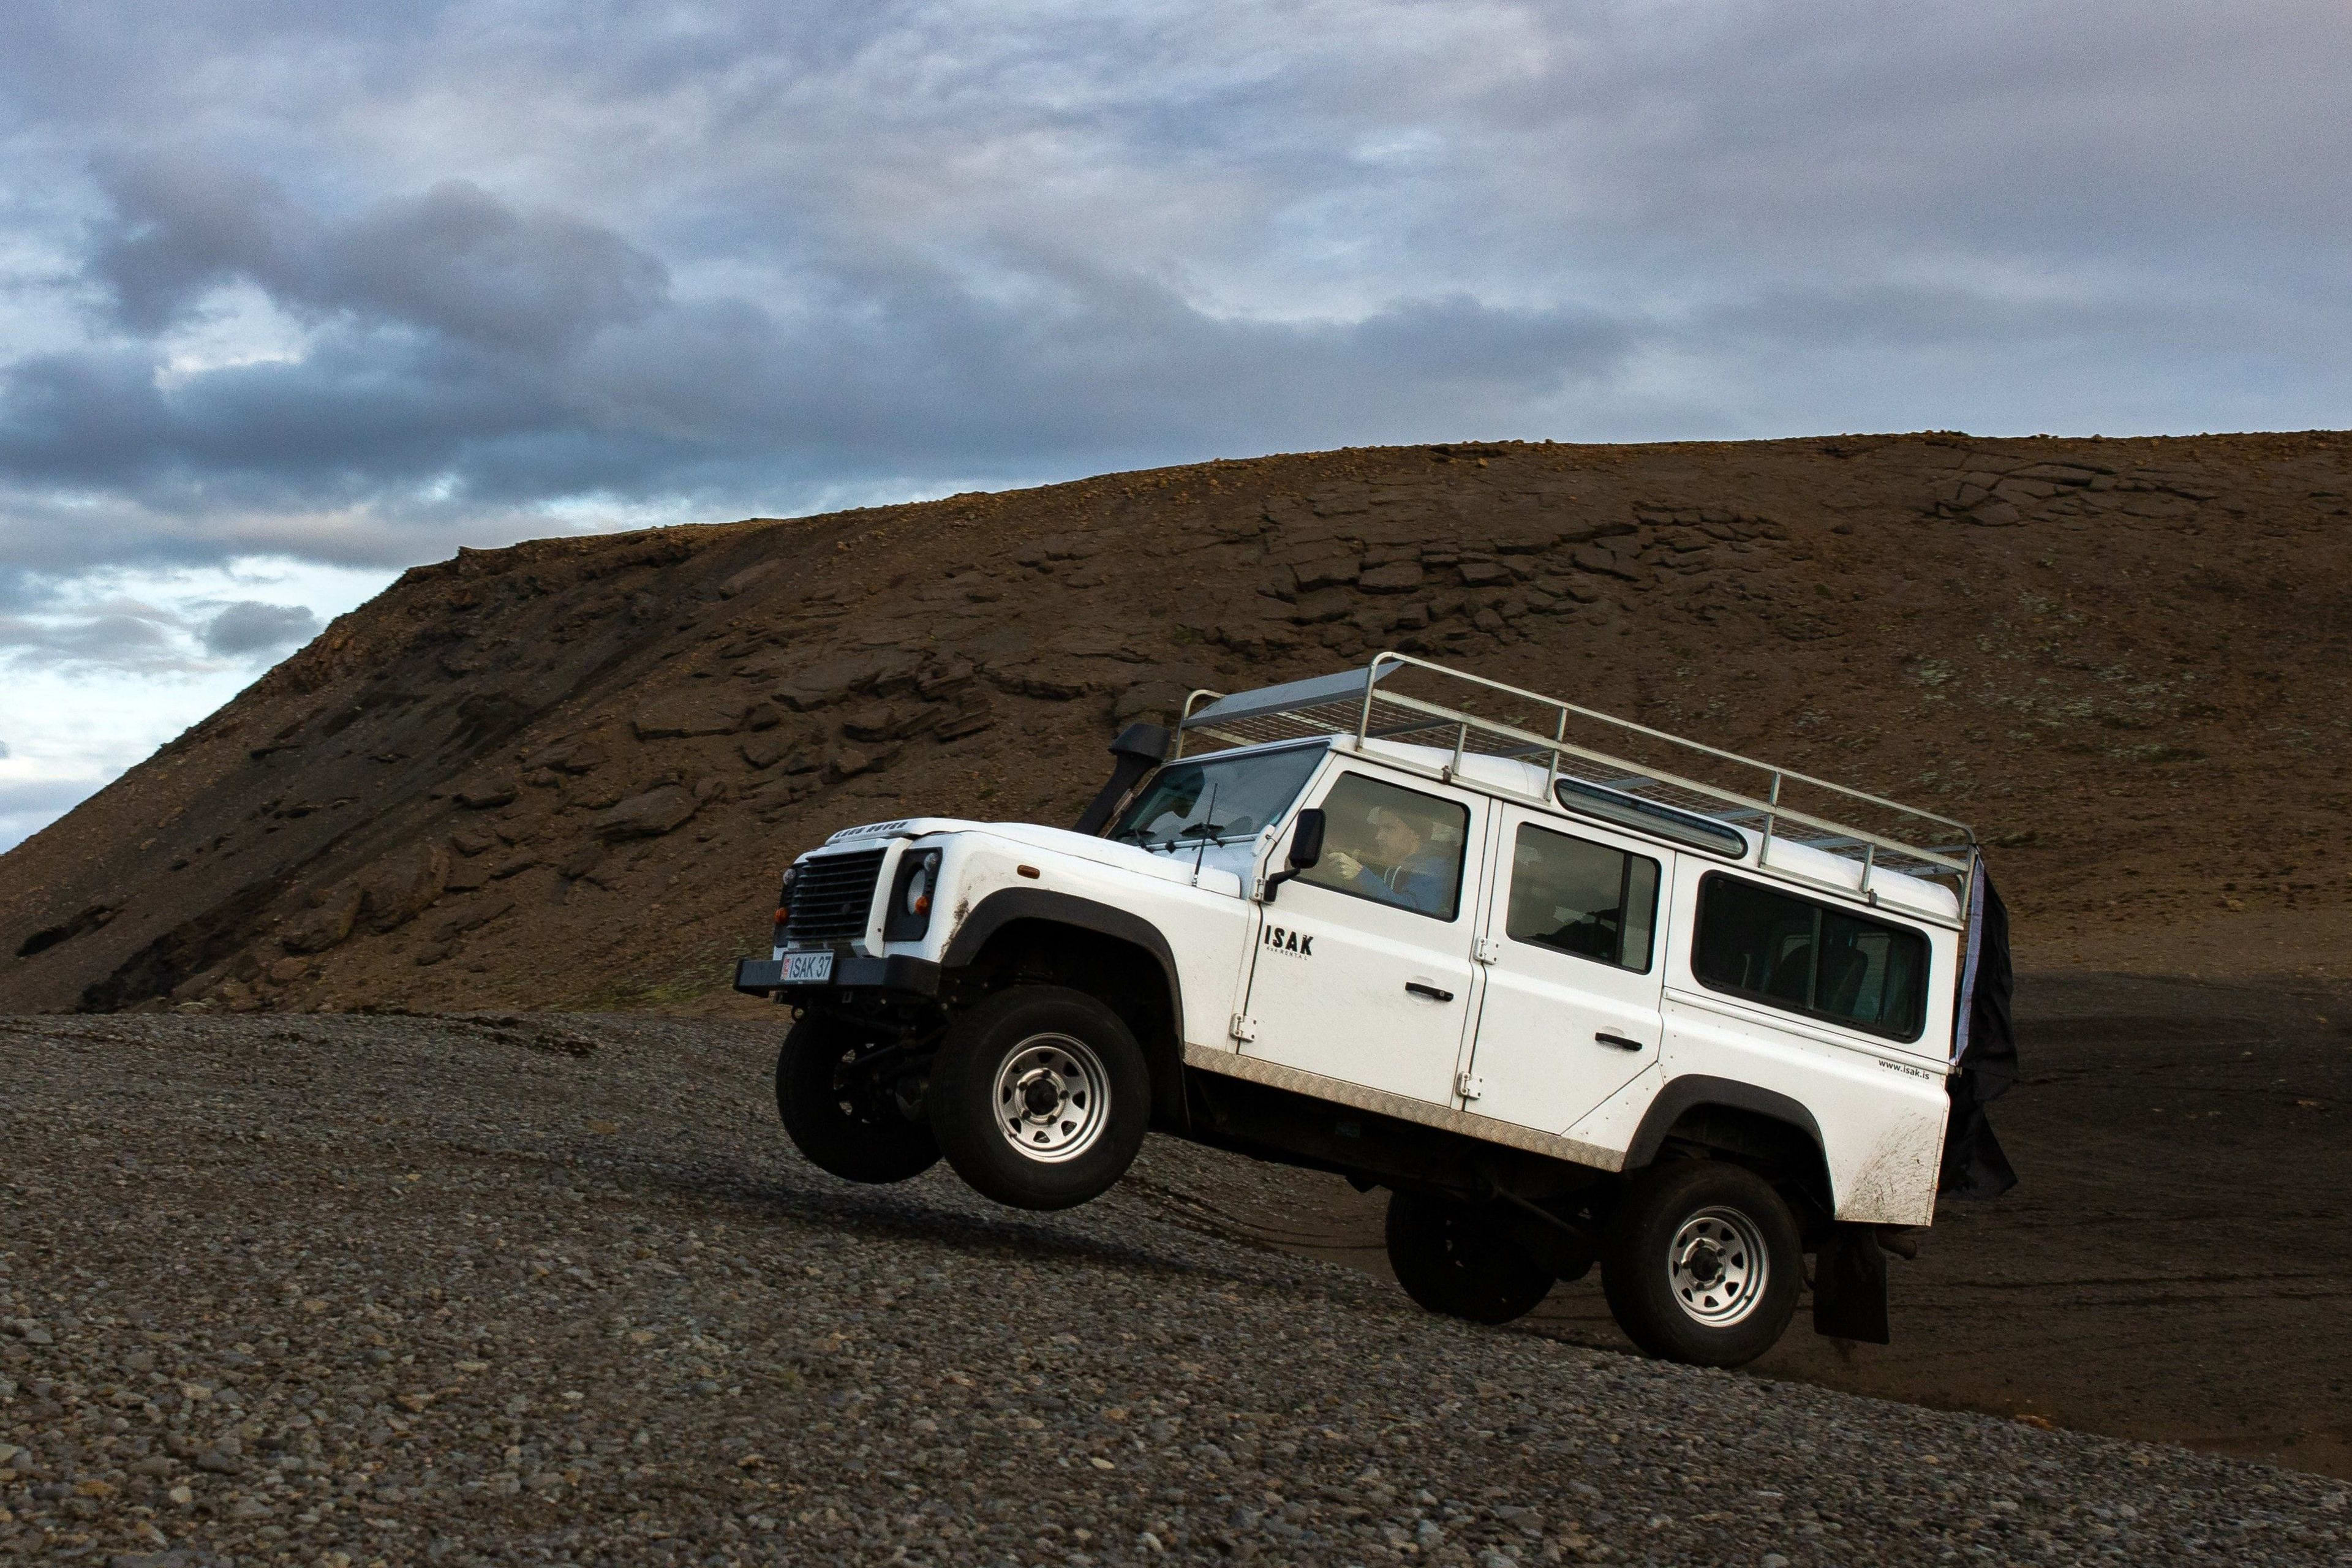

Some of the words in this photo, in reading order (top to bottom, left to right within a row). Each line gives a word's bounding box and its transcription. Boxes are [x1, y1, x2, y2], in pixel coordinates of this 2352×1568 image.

[866, 821, 908, 833] ROVER
[1264, 925, 1314, 956] ISAK
[1280, 949, 1307, 961] RENTAL
[789, 957, 816, 978] ISAK
[816, 956, 832, 978] 37
[1879, 1060, 1929, 1080] www.isak.is
